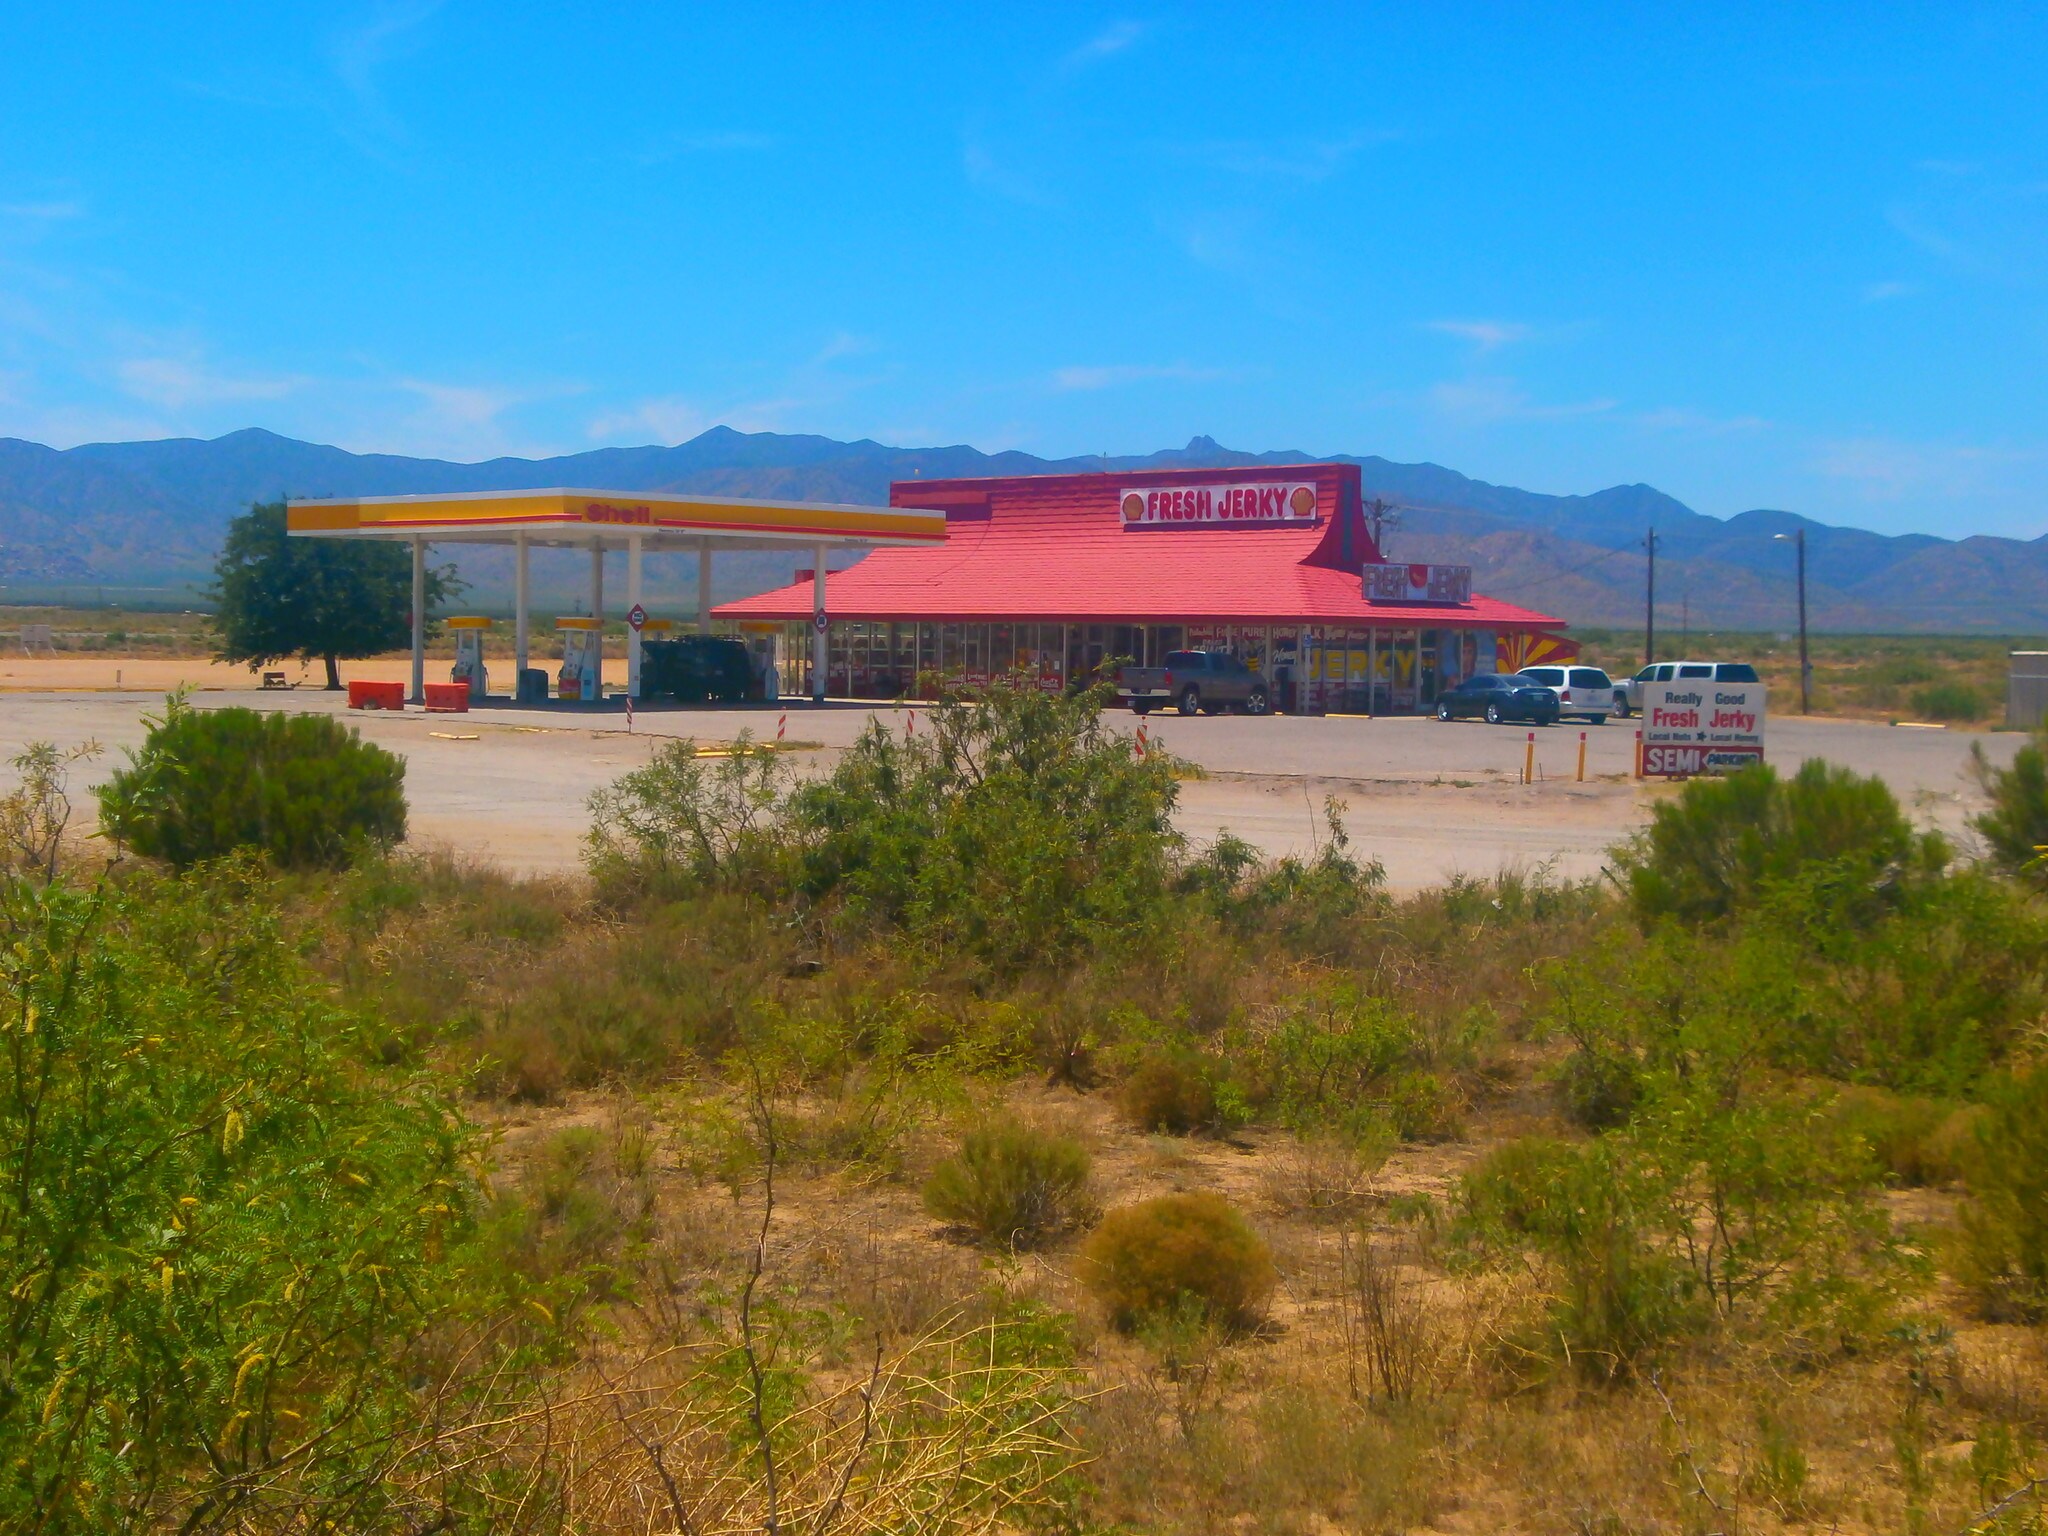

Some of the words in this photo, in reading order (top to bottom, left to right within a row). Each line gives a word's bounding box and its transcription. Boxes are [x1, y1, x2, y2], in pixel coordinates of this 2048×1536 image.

[587, 504, 650, 523] Shell
[1148, 491, 1211, 520] FRESH
[1218, 487, 1287, 518] JERKY
[1242, 627, 1265, 637] PURE
[1310, 649, 1417, 680] JERKY
[1665, 692, 1702, 707] Really
[1715, 693, 1745, 705] Good
[1653, 708, 1698, 727] Fresh
[1710, 709, 1755, 732] Jerky
[1647, 748, 1699, 772] SEMI
